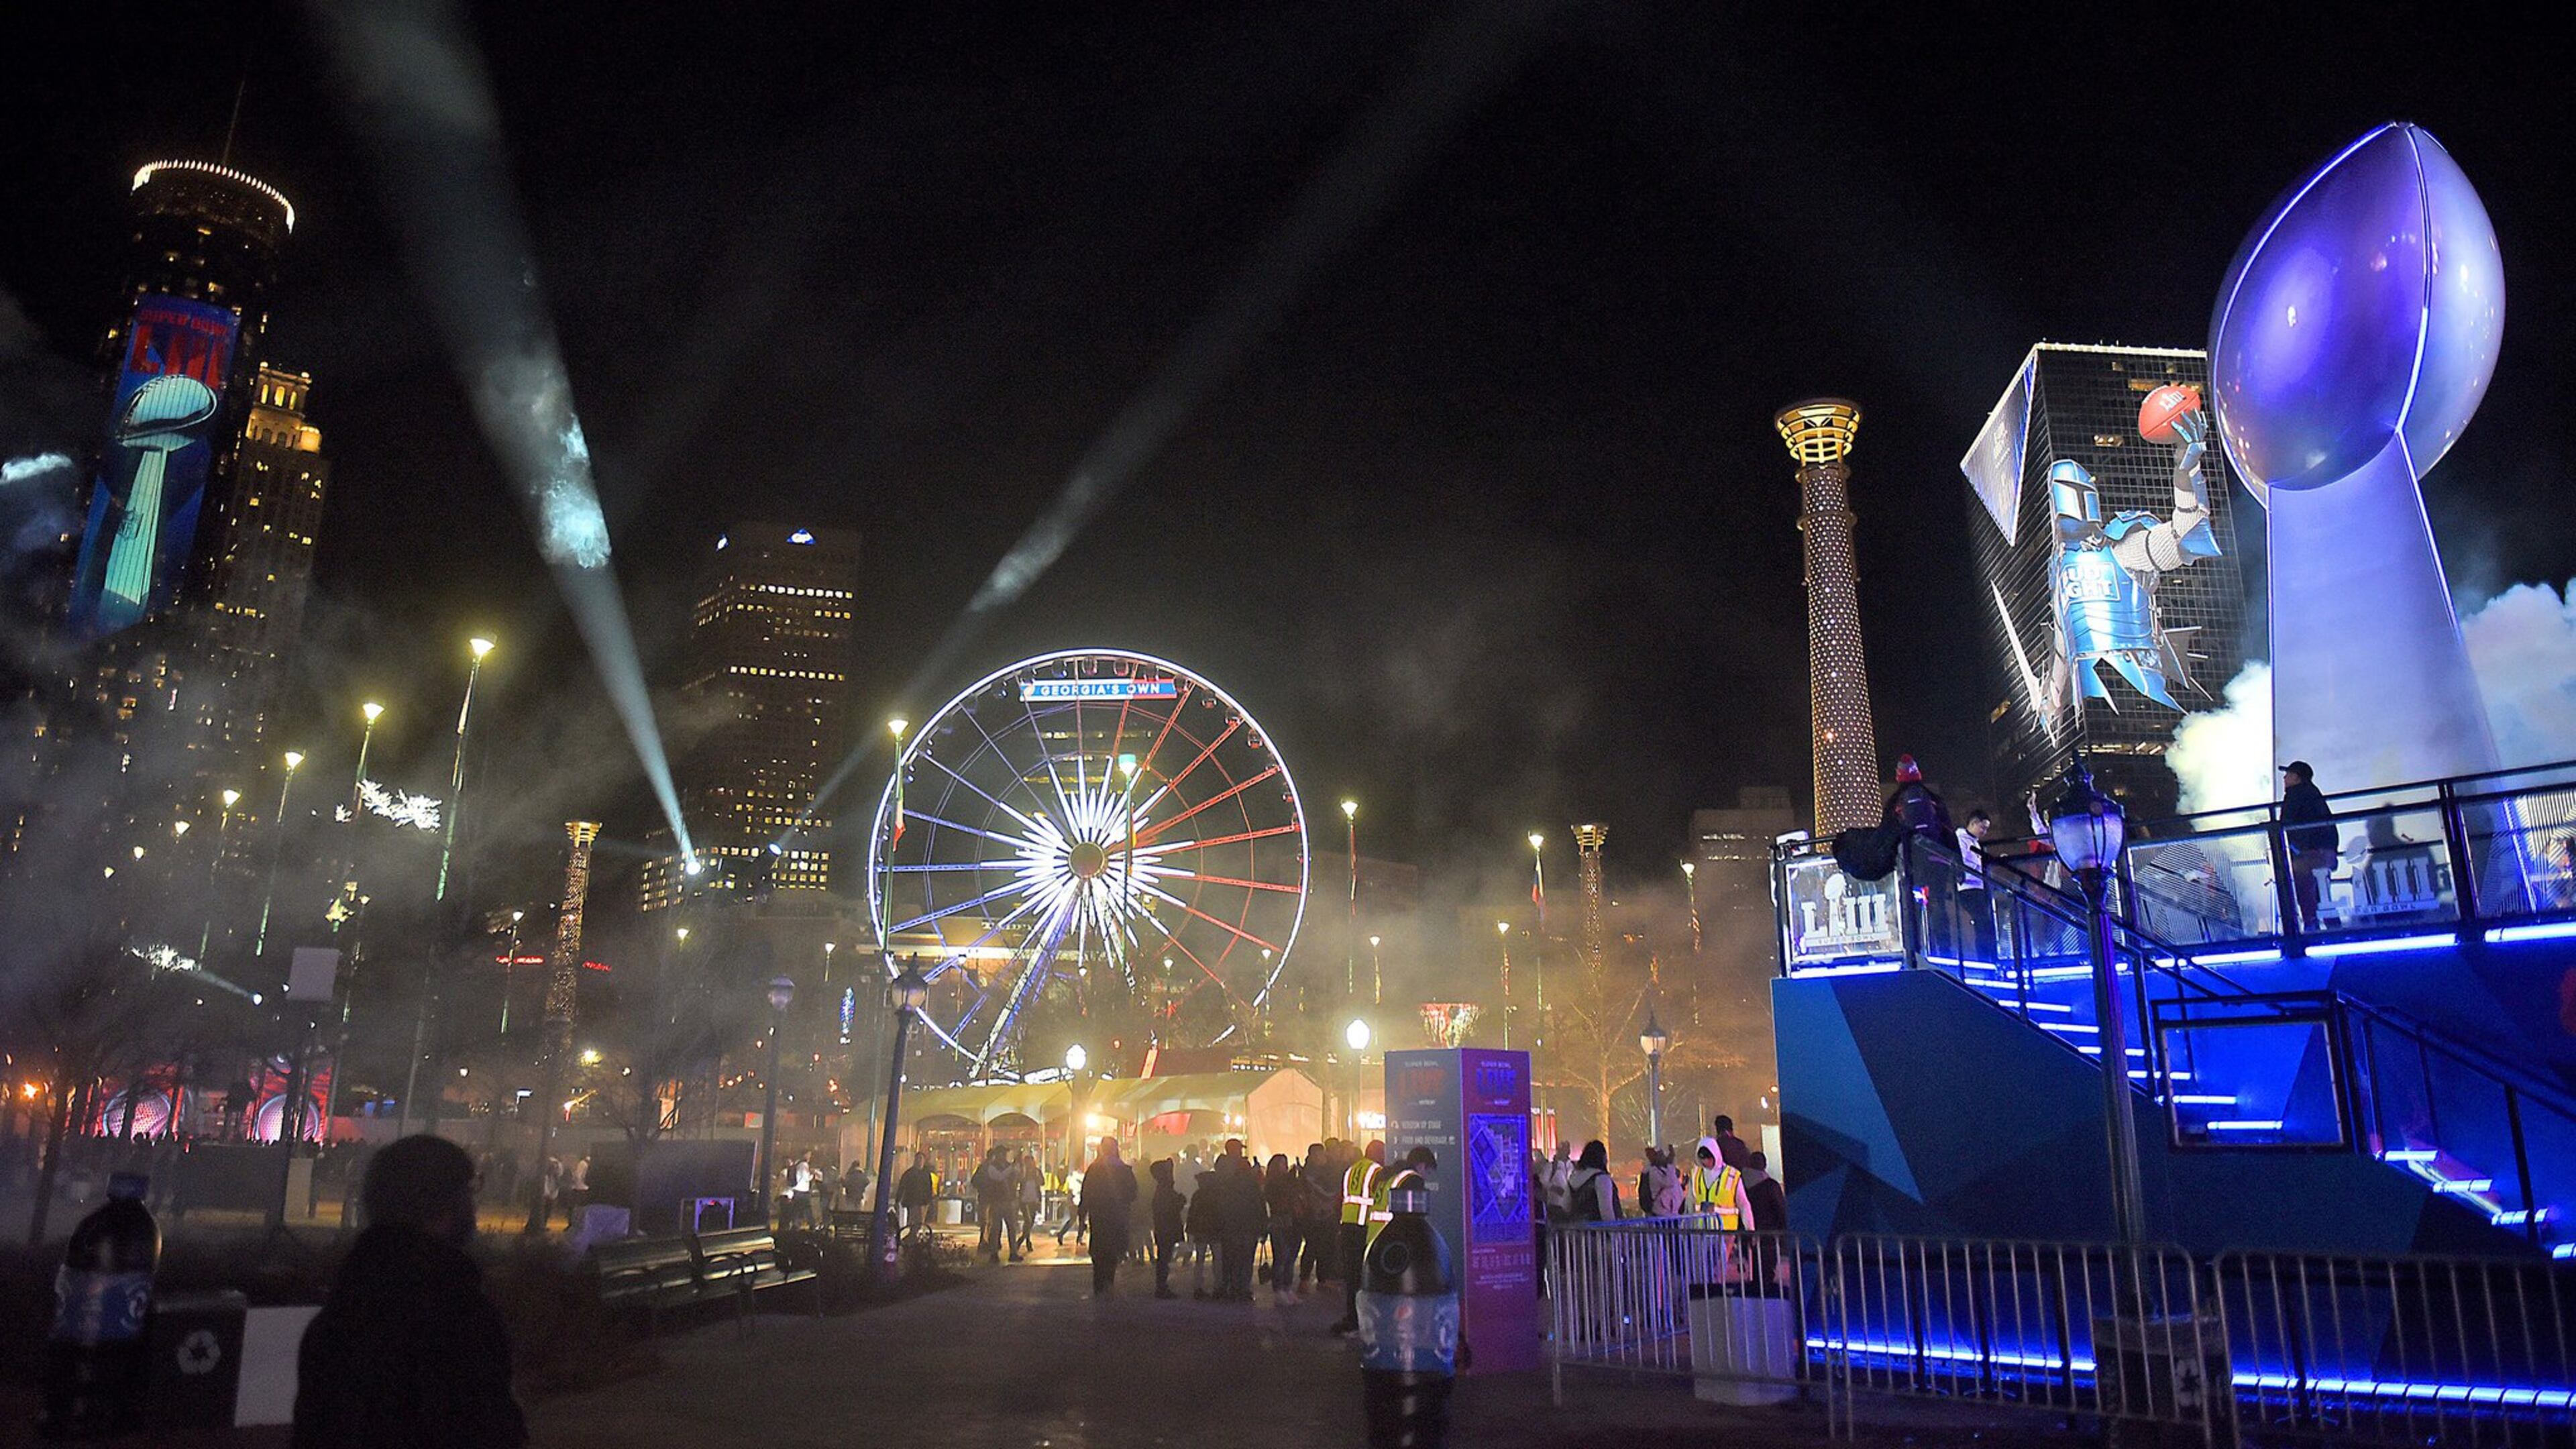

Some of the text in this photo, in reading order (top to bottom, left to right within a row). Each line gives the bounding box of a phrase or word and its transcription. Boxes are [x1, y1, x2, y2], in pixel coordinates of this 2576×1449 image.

[1040, 683, 1161, 696] GEORGIA'S OWN
[2383, 902, 2416, 912] BOWL
